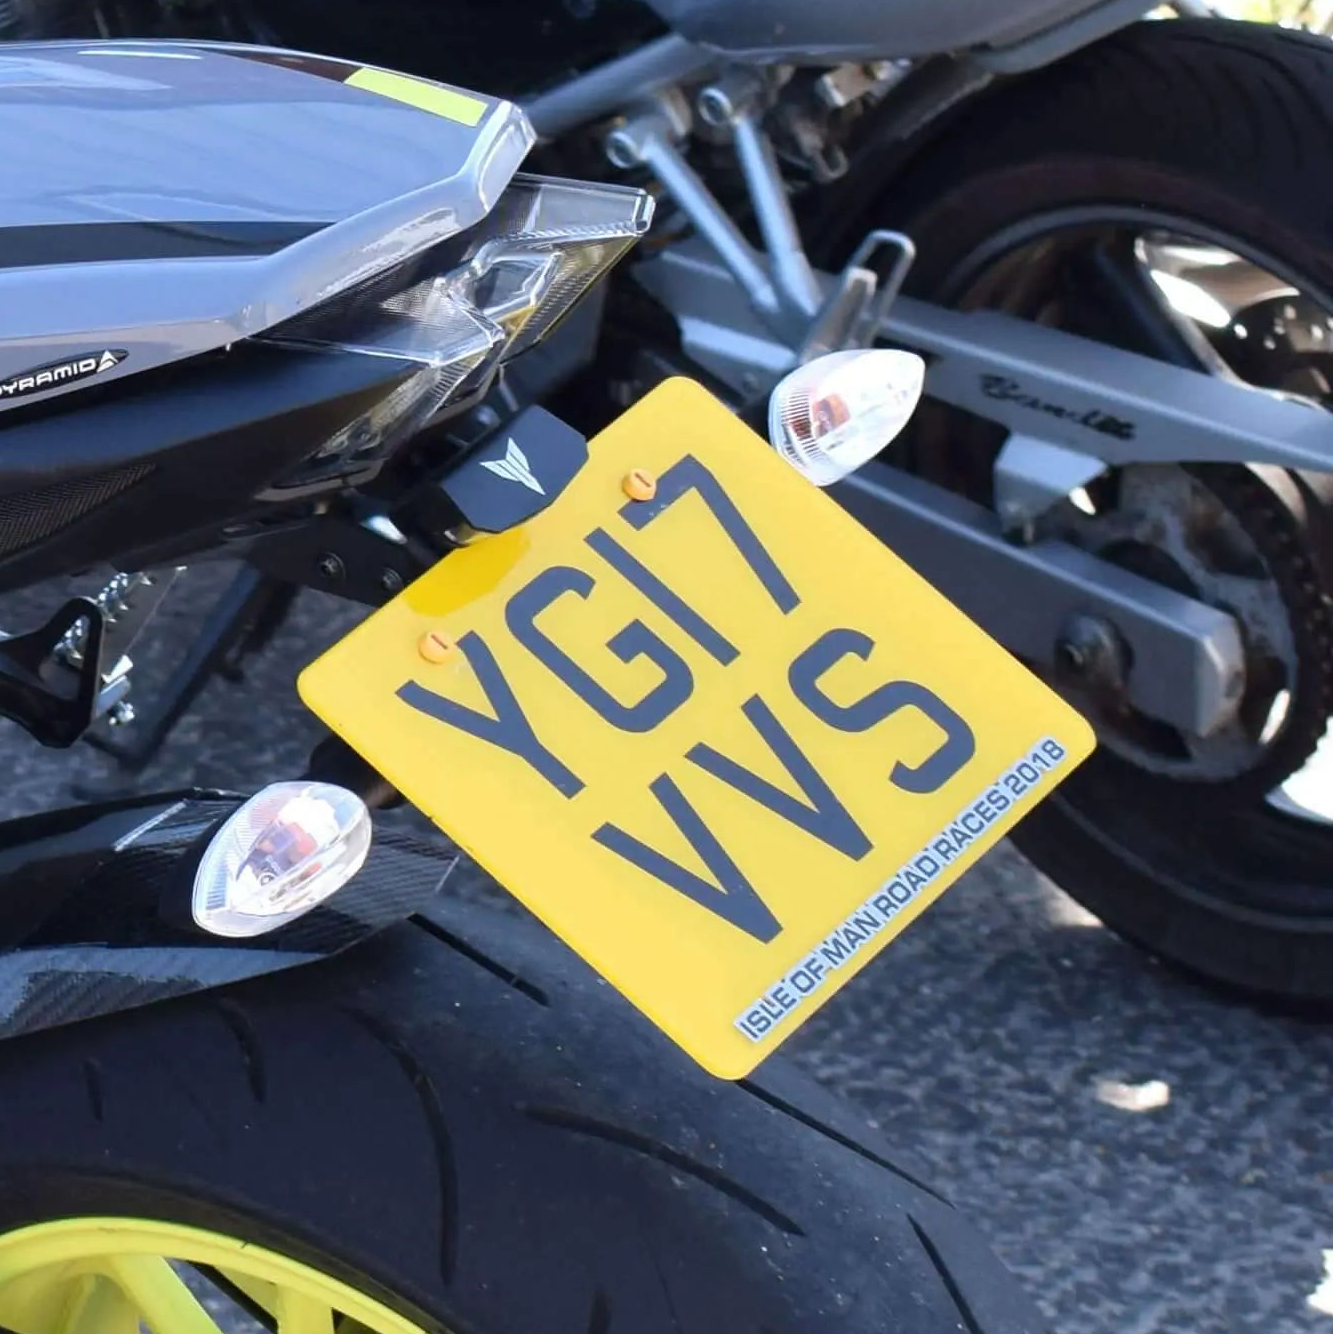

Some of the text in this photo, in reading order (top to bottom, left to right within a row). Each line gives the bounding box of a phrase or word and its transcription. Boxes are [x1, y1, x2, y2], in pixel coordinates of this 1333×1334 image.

[395, 453, 800, 799] YG17
[591, 627, 976, 945] VVS
[739, 738, 1066, 1041] ISLE OF MAN ROAD RACES 2018
